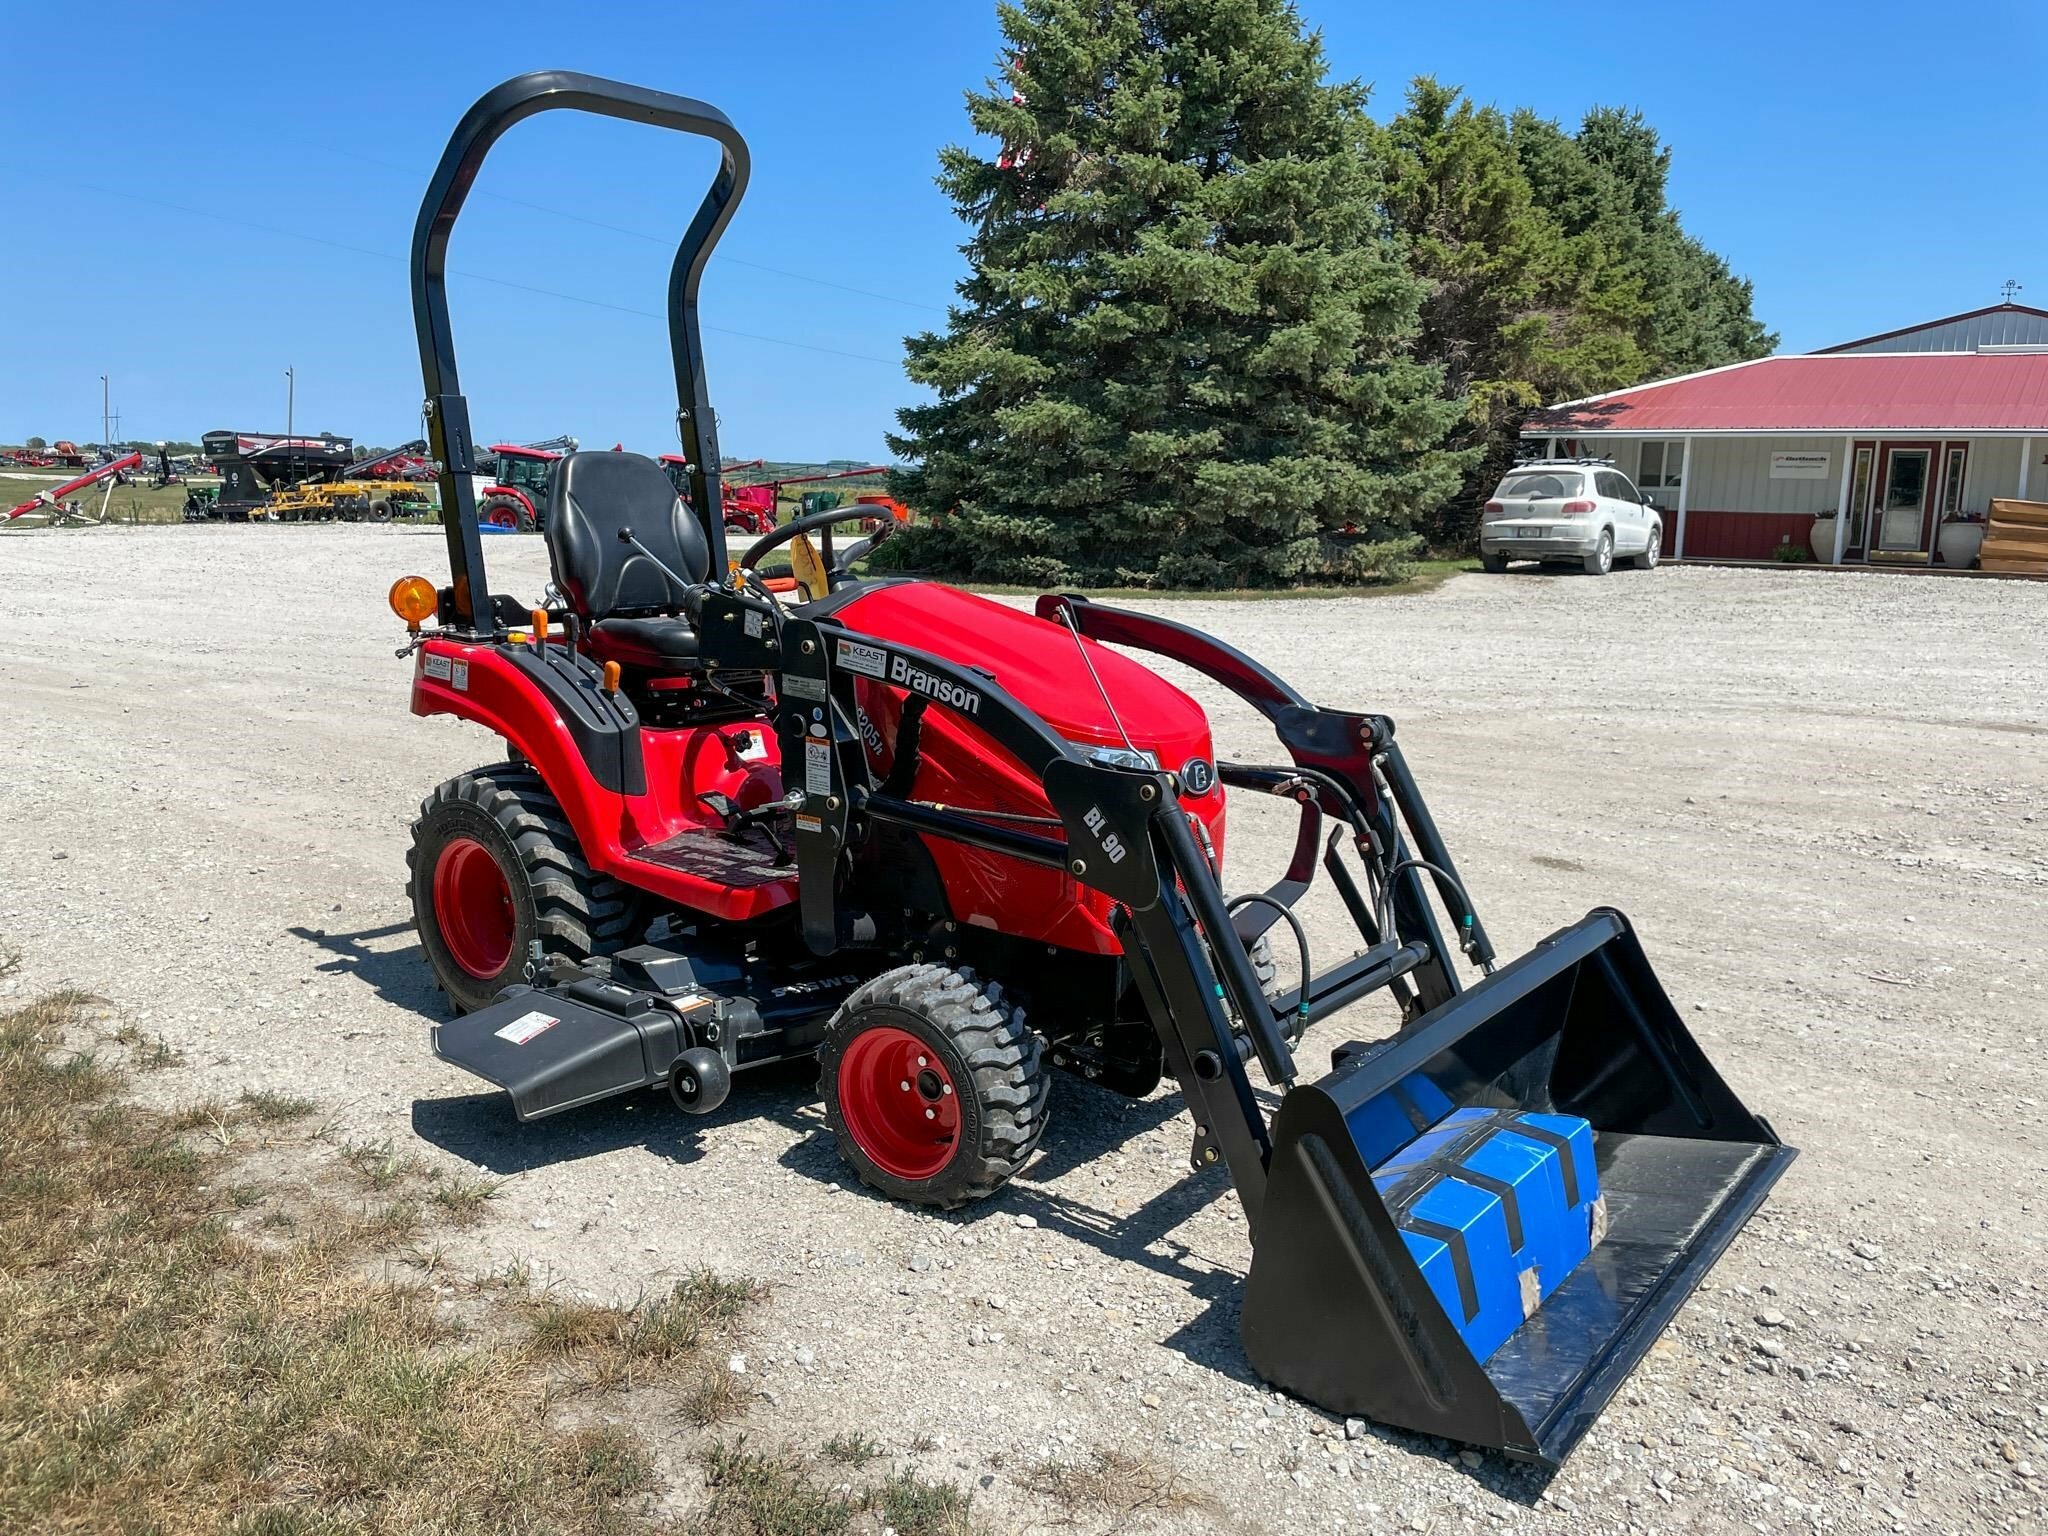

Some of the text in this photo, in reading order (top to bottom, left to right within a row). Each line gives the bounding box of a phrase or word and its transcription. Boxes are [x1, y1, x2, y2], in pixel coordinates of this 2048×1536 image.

[852, 646, 885, 662] KEAST
[891, 655, 980, 715] Branson
[1083, 805, 1126, 864] BL 90
